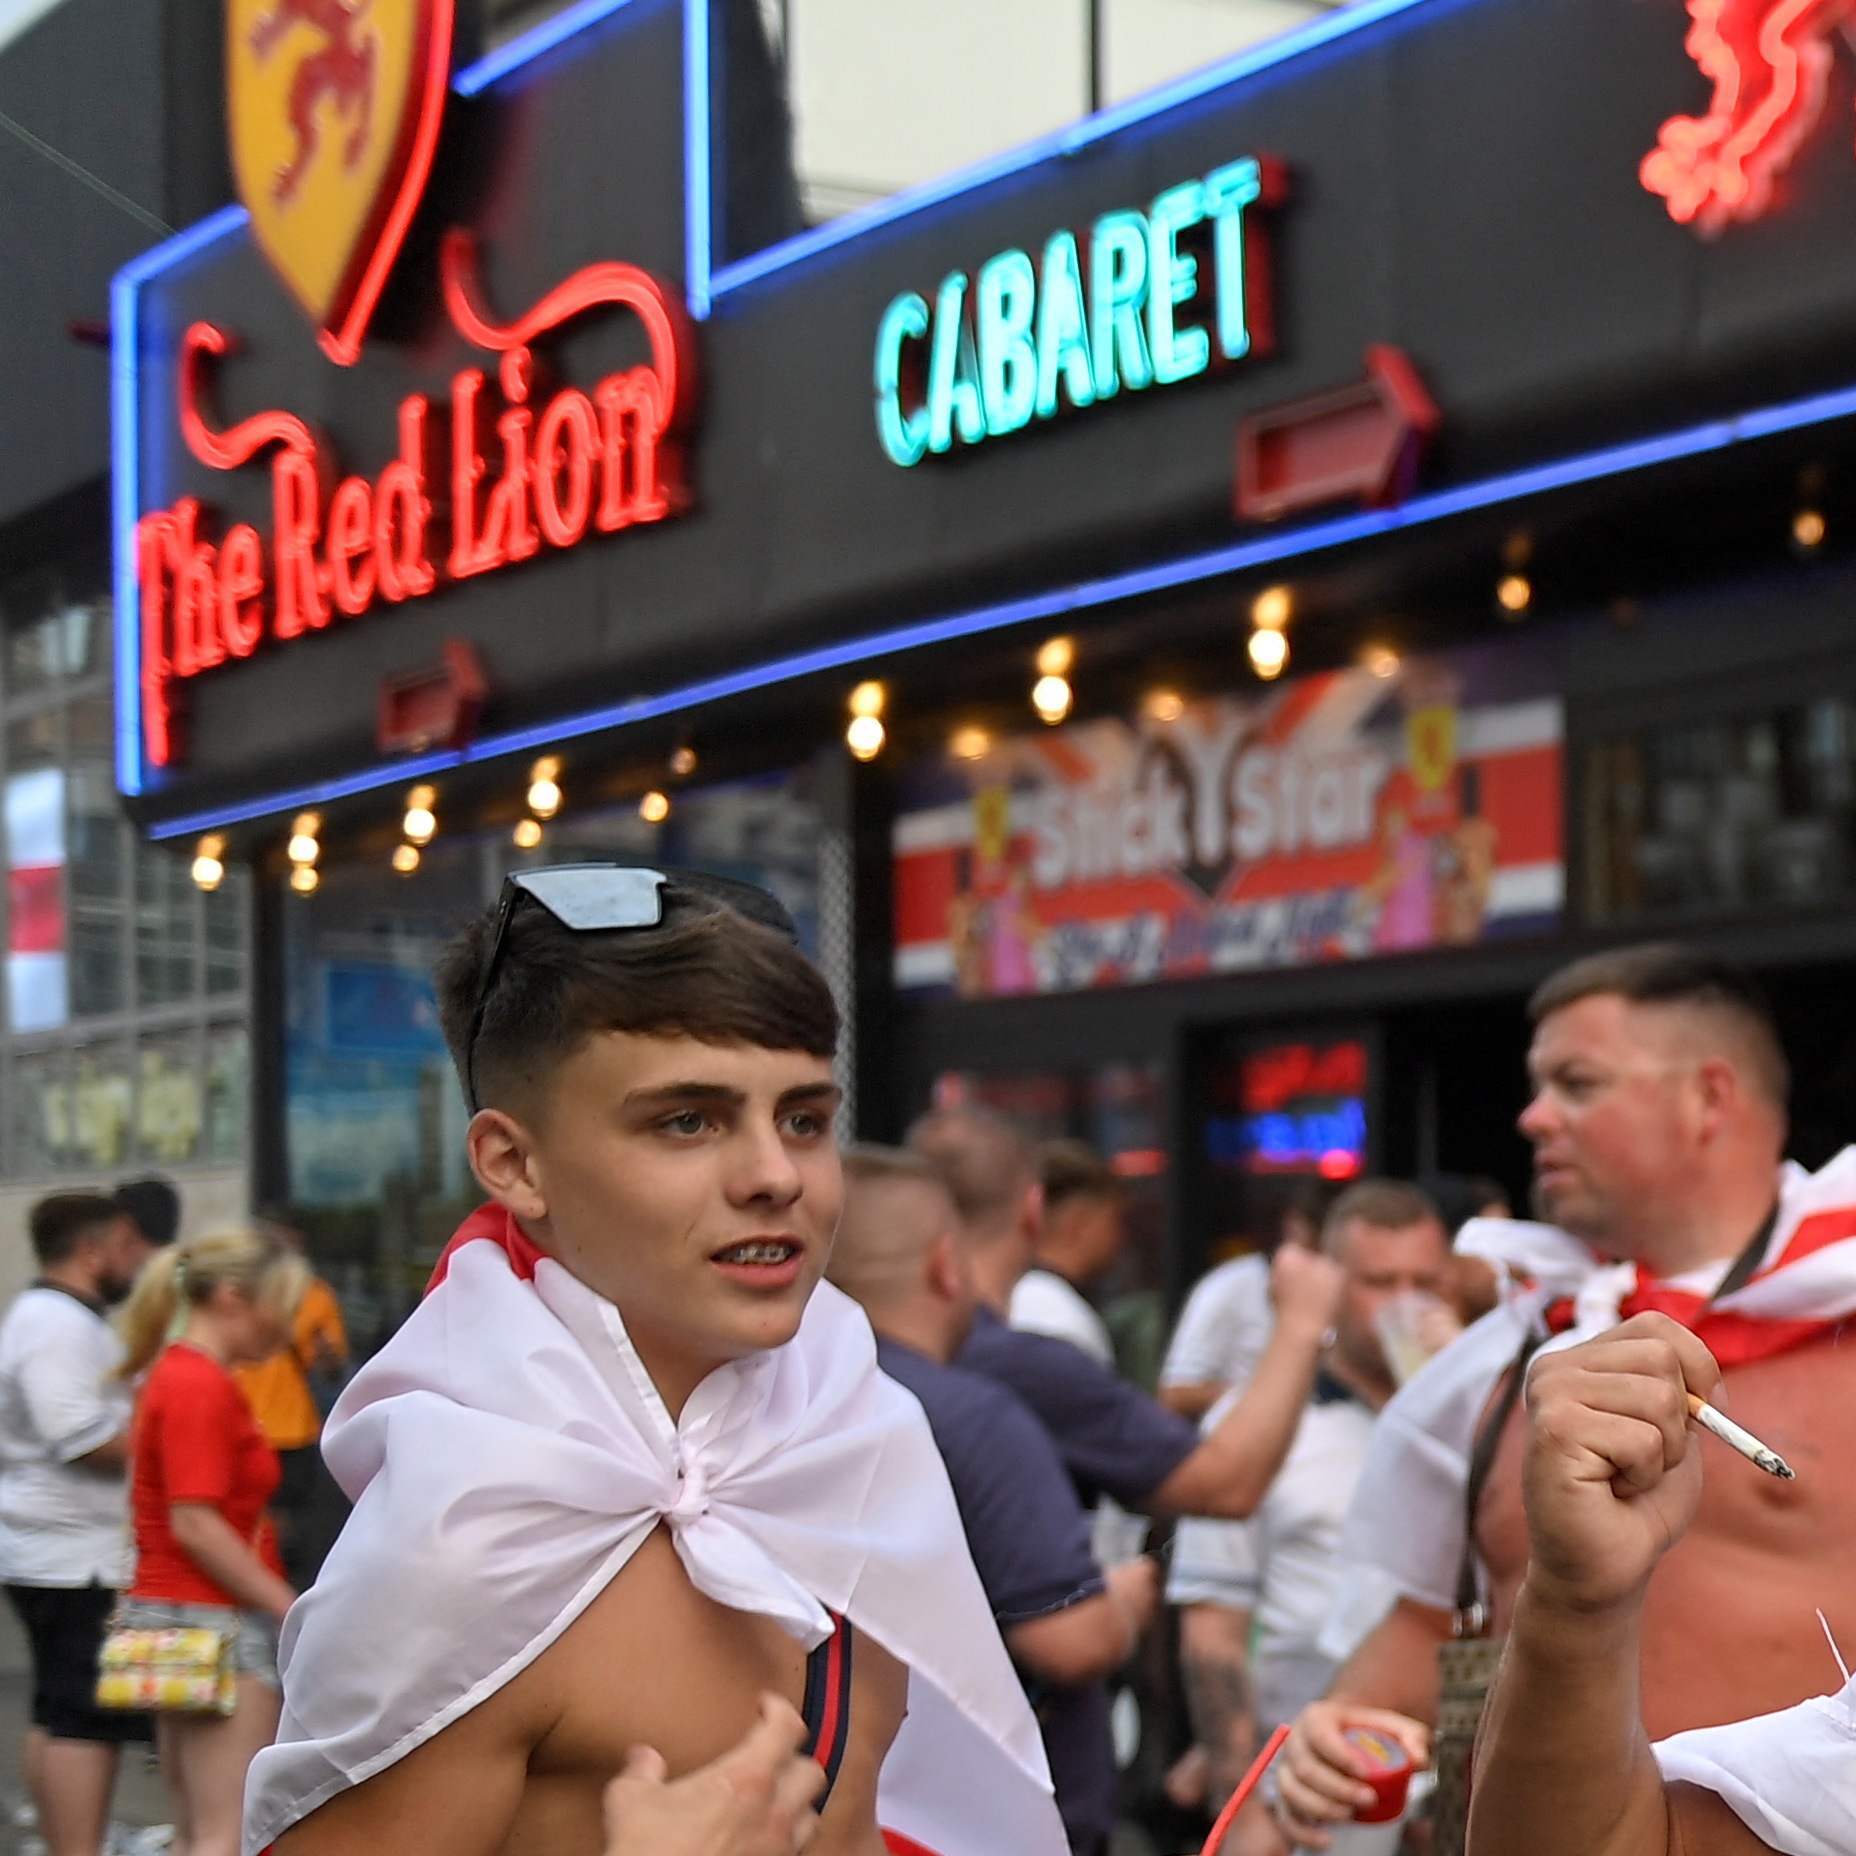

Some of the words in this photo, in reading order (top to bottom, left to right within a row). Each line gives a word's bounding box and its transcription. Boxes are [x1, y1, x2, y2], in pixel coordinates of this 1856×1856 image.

[873, 156, 1262, 467] CABARET
[136, 497, 263, 766] The
[447, 345, 680, 579] Lion
